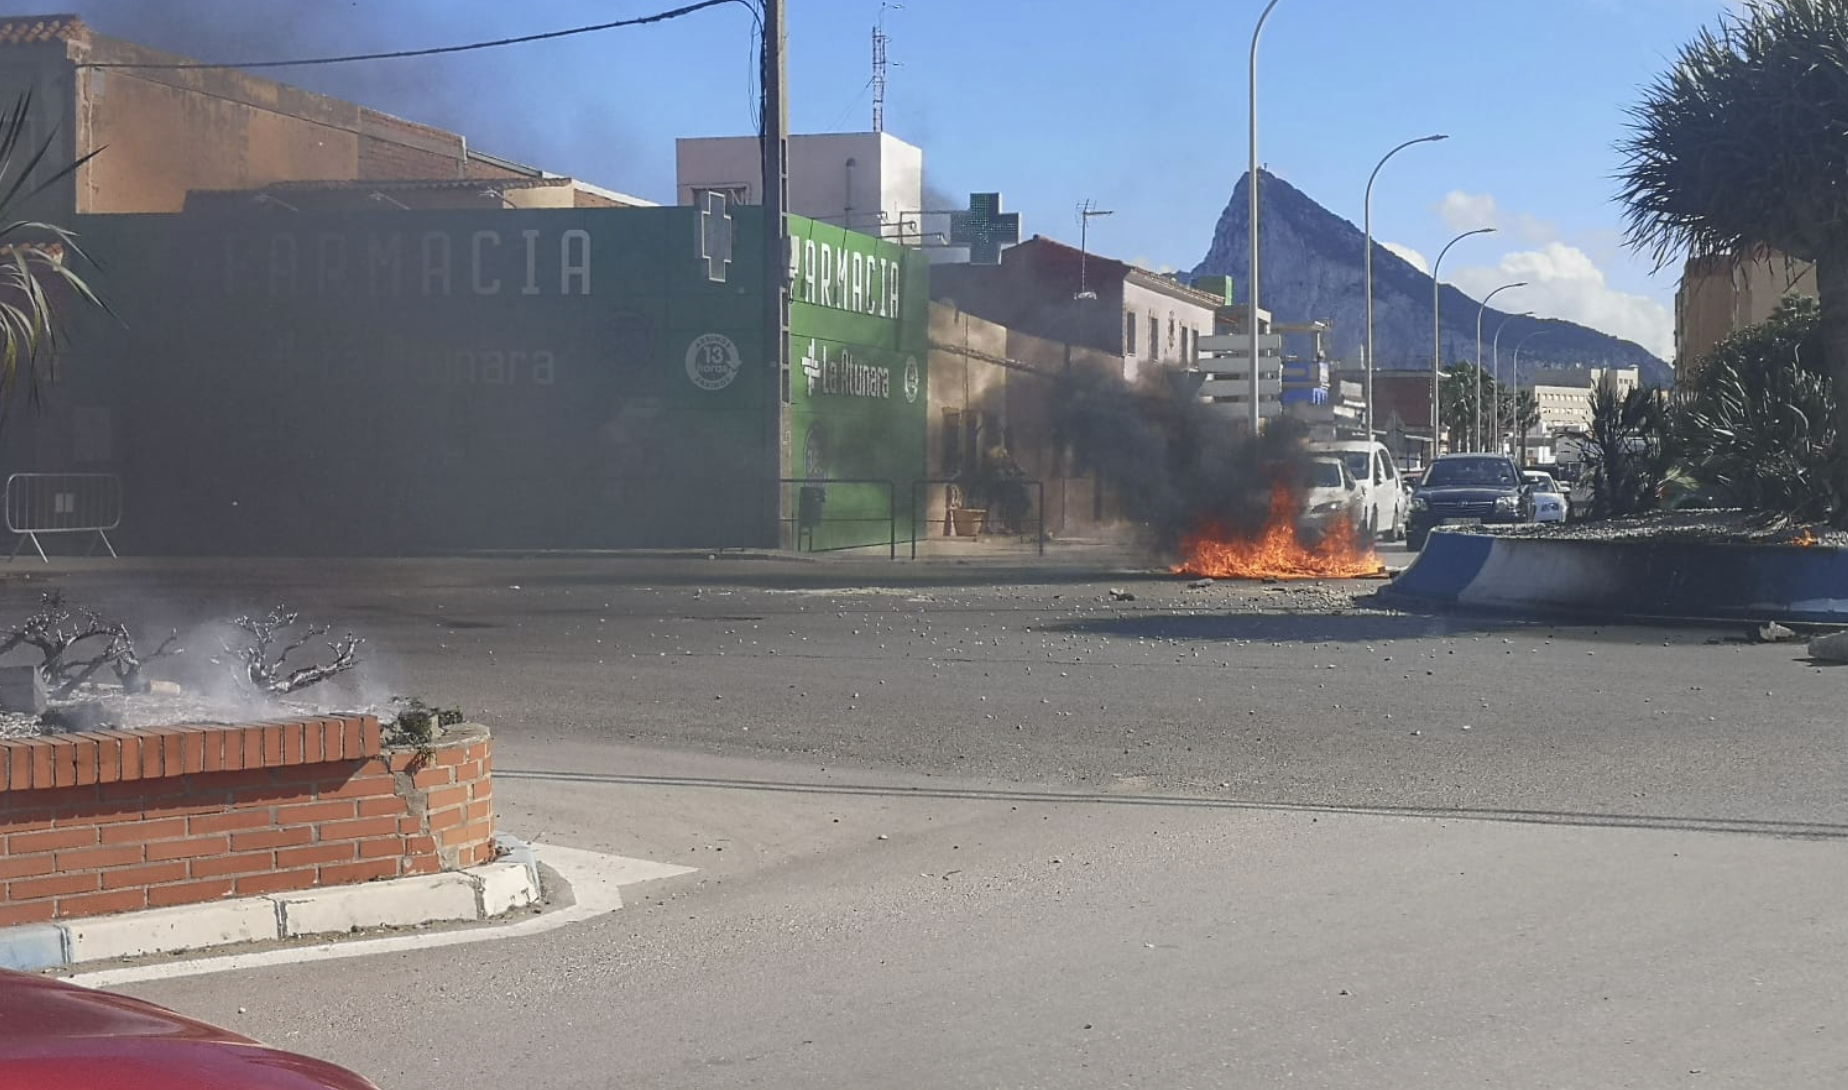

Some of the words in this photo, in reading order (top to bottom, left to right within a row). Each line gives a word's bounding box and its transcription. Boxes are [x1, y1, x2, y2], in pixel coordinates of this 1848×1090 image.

[223, 228, 592, 296] FARMACIA
[703, 345, 724, 364] 13
[822, 345, 837, 394] La
[841, 348, 890, 399] Atunara
